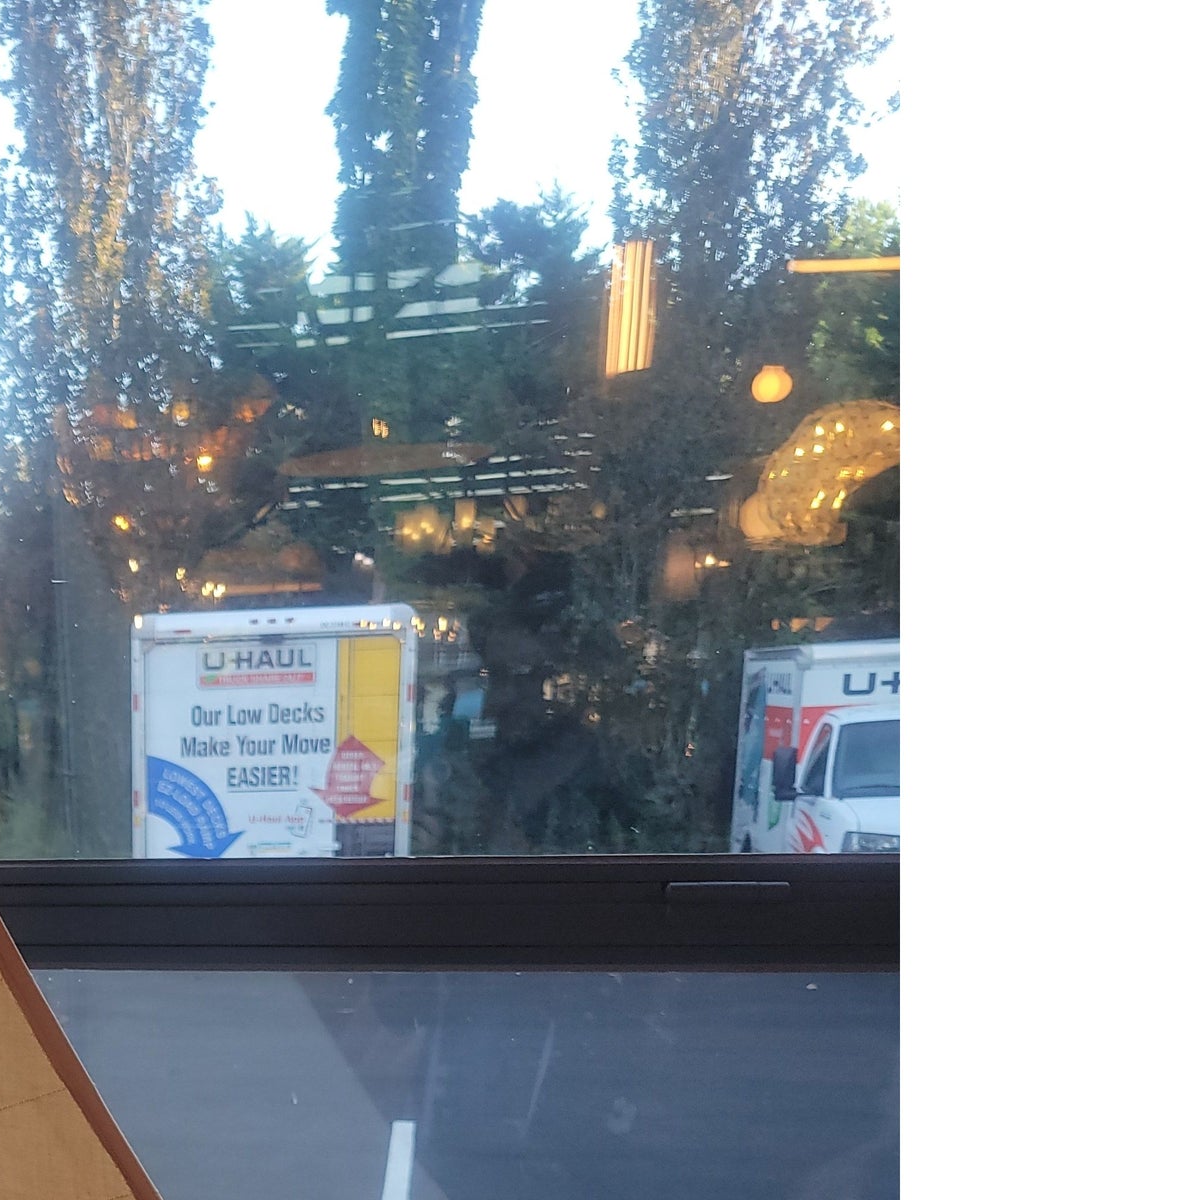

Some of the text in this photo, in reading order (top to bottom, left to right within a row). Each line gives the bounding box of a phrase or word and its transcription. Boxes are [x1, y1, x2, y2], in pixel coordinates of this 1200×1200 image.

[202, 649, 312, 671] U-HAUL
[191, 702, 325, 727] Our Low Decks
[181, 732, 331, 757] Make Your Move
[227, 765, 298, 788] EASIER!
